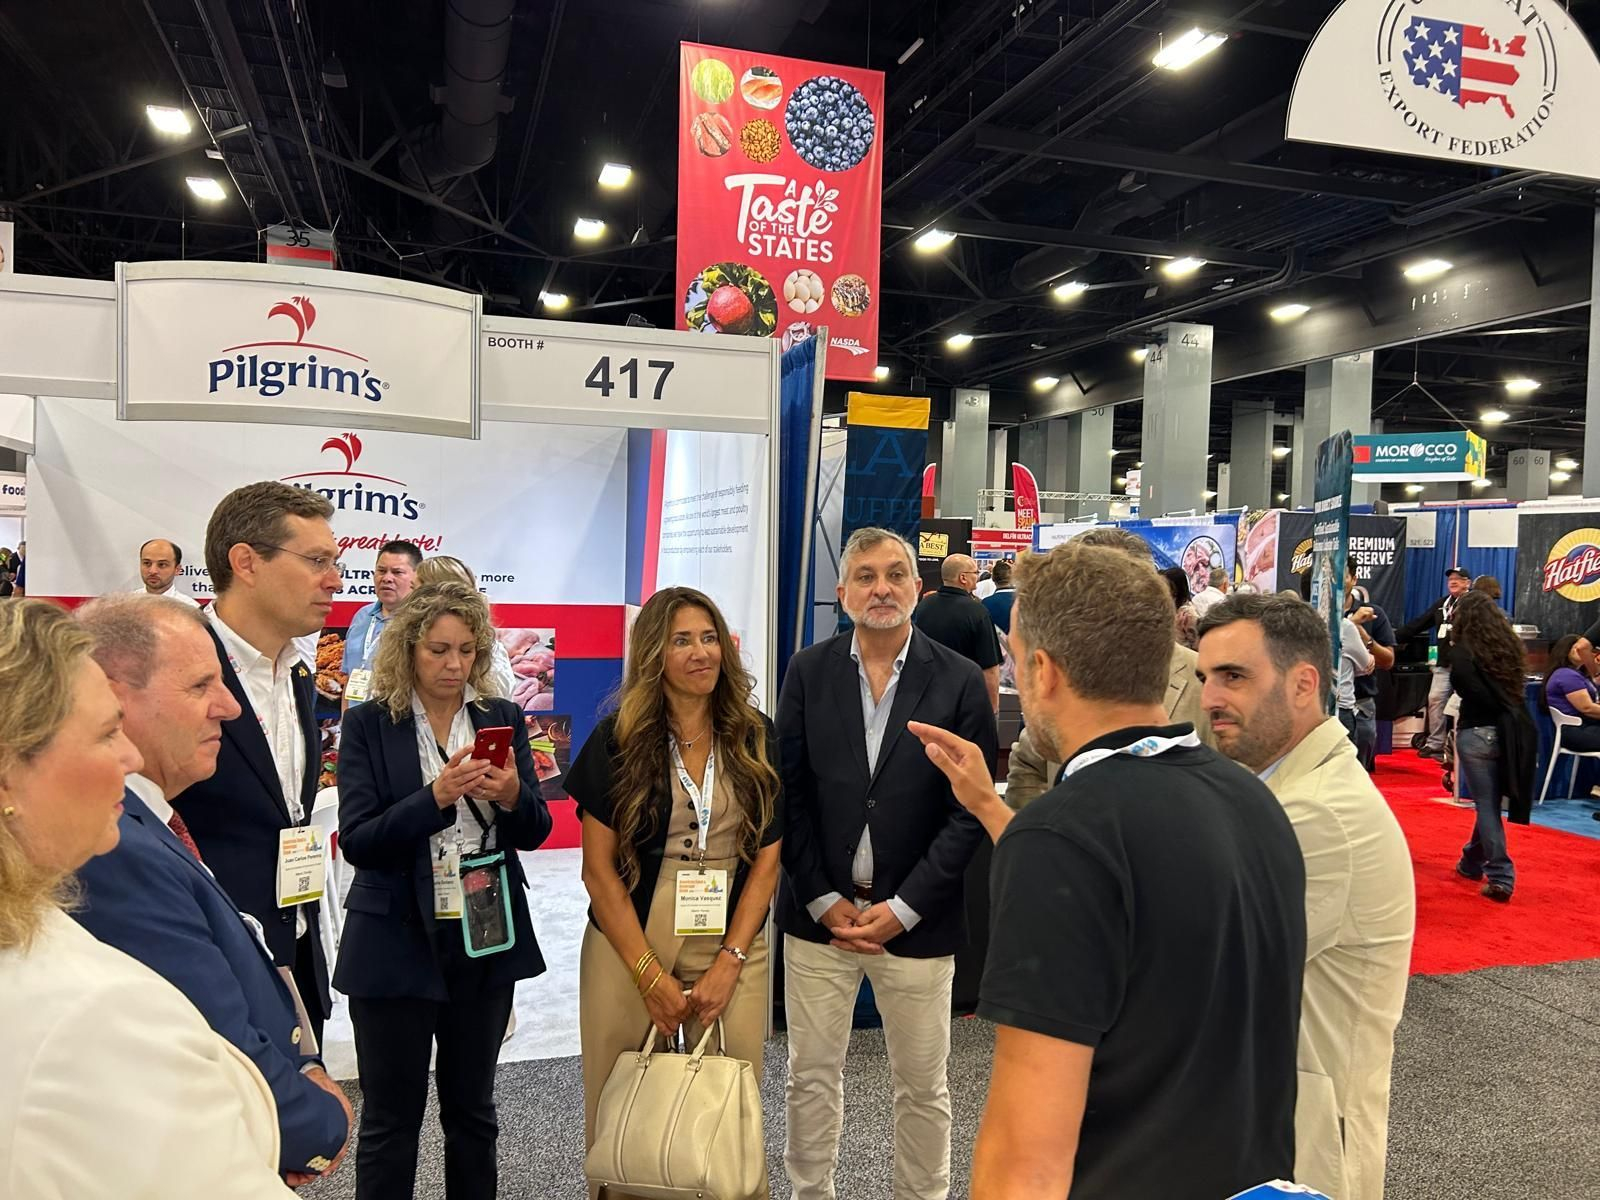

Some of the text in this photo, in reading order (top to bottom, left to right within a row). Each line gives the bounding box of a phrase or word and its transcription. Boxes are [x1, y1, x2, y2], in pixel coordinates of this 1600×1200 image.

[1379, 70, 1555, 156] EXPORT FEDERATION
[785, 179, 797, 198] A
[724, 173, 833, 244] Taste
[749, 221, 794, 236] OF THE
[285, 229, 310, 248] 35
[748, 234, 833, 263] STATES
[488, 337, 545, 350] BOOTH #
[830, 337, 860, 347] NASDA
[1181, 333, 1199, 348] 44
[1150, 350, 1163, 364] 44
[208, 354, 383, 402] Pilgrim's
[585, 356, 675, 400] 417
[1375, 442, 1457, 458] MOROCCO
[1513, 456, 1525, 465] 60
[1534, 456, 1544, 465] 60
[925, 542, 945, 551] BEST
[481, 574, 515, 583] more
